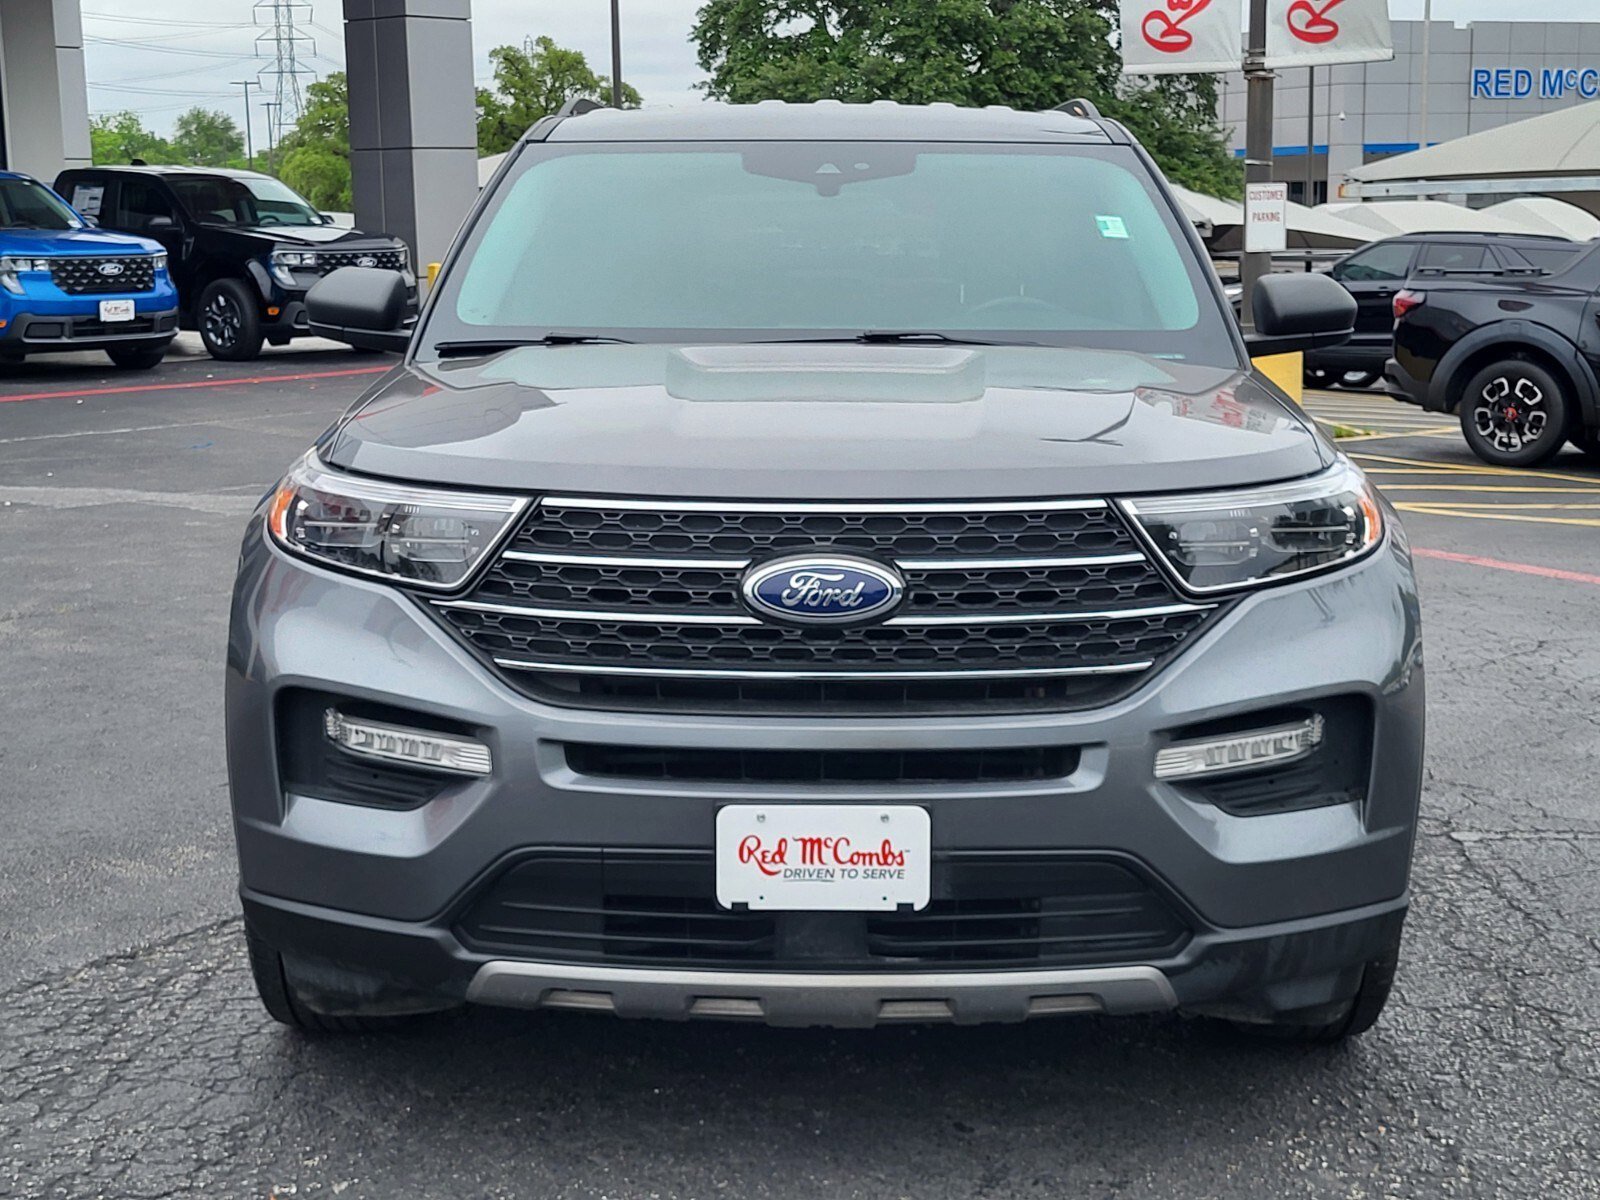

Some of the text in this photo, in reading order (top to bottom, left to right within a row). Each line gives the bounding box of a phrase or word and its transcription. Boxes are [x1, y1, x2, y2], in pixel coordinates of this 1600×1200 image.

[1287, 0, 1346, 44] R
[1473, 69, 1600, 97] RED McC
[1249, 190, 1284, 201] CUSTOMER
[1252, 211, 1281, 222] PARKING
[781, 571, 866, 608] Ford
[738, 835, 906, 876] Red McCombs
[783, 868, 906, 880] DRIVEN TO SERVE
